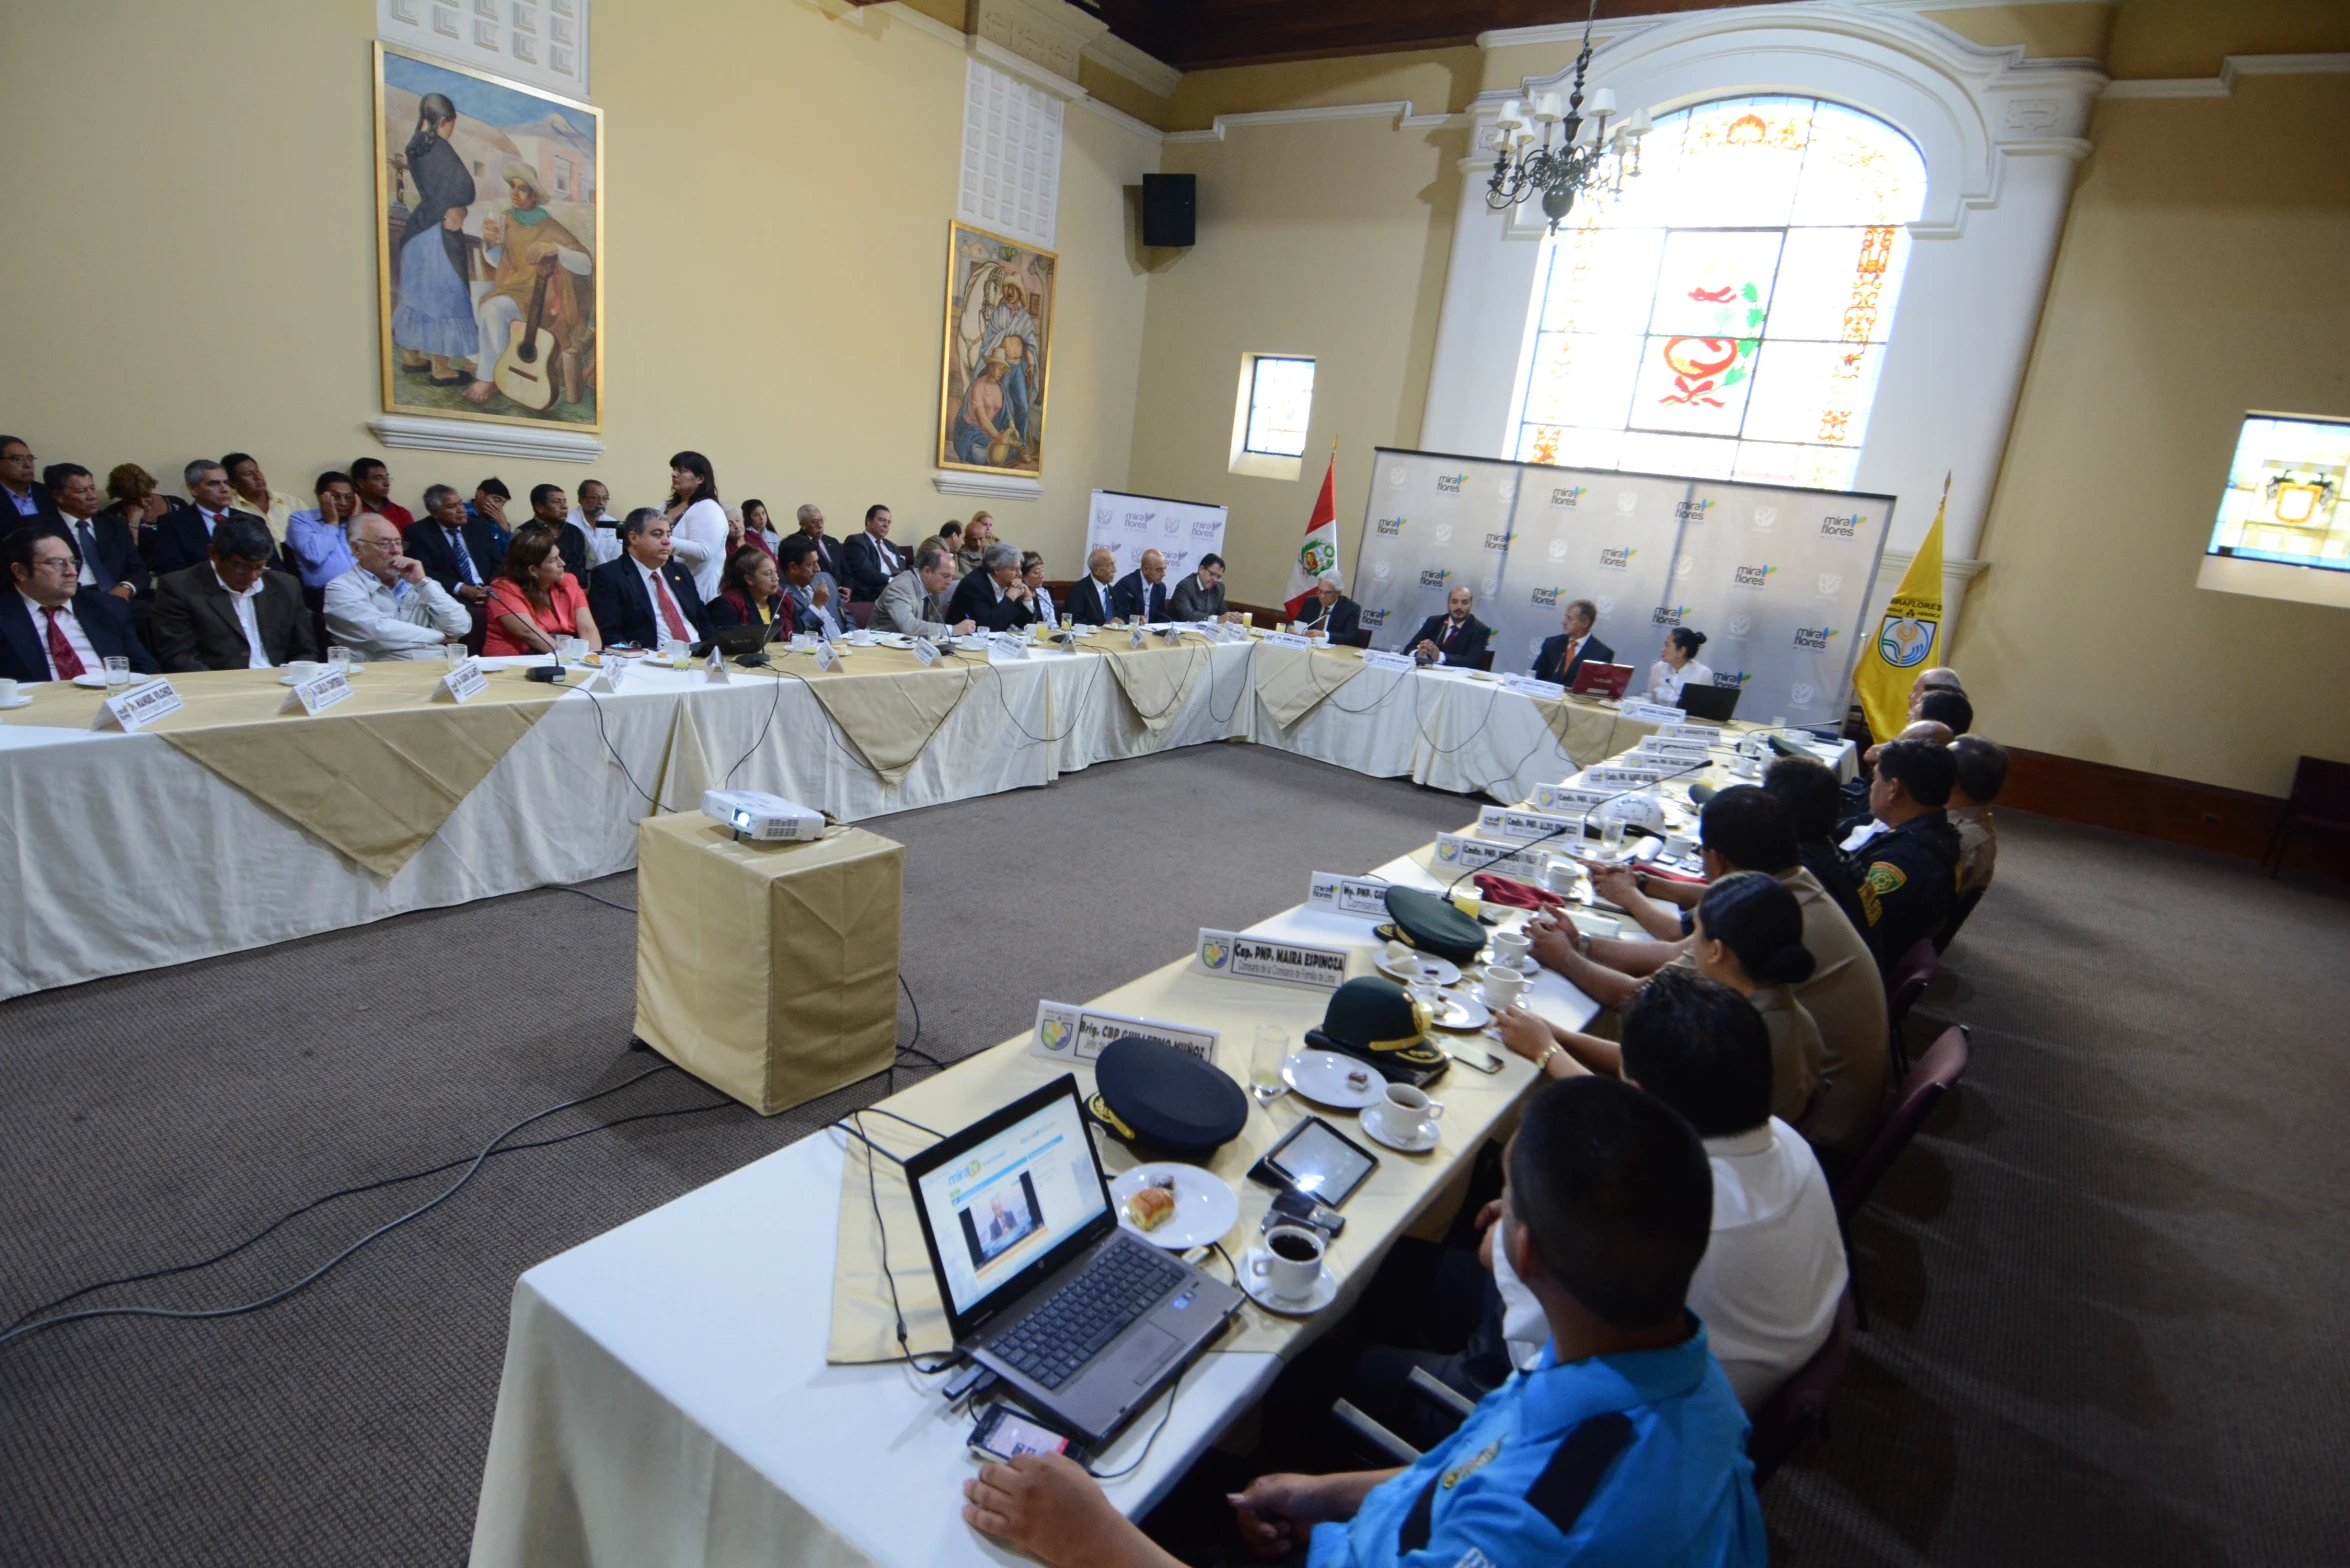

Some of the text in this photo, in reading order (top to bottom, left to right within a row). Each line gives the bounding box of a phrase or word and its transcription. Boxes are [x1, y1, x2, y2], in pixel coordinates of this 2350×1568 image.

[1439, 475, 1458, 485] mira
[1437, 482, 1460, 493] flores
[1553, 487, 1574, 497] mira
[1551, 495, 1577, 506] flores
[1678, 500, 1701, 510] mira
[1125, 512, 1144, 521] mira
[1675, 508, 1704, 520] flores
[1124, 519, 1147, 529] flores
[1193, 521, 1211, 530] mira
[1378, 518, 1397, 527] mira
[1824, 516, 1850, 526] mira
[1191, 528, 1214, 538] flores
[1377, 525, 1399, 536] flores
[1821, 524, 1854, 537] flores
[1486, 532, 1505, 542] mira
[1484, 540, 1509, 551] flores
[1602, 548, 1624, 558] mira
[1600, 555, 1627, 567] flores
[1422, 570, 1441, 580] mira
[1737, 565, 1761, 576] mira
[1419, 577, 1444, 588] flores
[1734, 573, 1765, 586] flores
[1533, 587, 1554, 597] mira
[1531, 594, 1556, 606] flores
[1363, 609, 1381, 618] mira
[1655, 606, 1677, 616] mira
[1361, 616, 1383, 626] flores
[1652, 614, 1681, 626] flores
[1797, 628, 1822, 639] mira
[1794, 635, 1826, 649] flores
[1234, 944, 1344, 972] Cap. PNP. MAIRA ESPINOZA
[1080, 1020, 1099, 1039] Brig.
[1102, 1025, 1120, 1040] CBP
